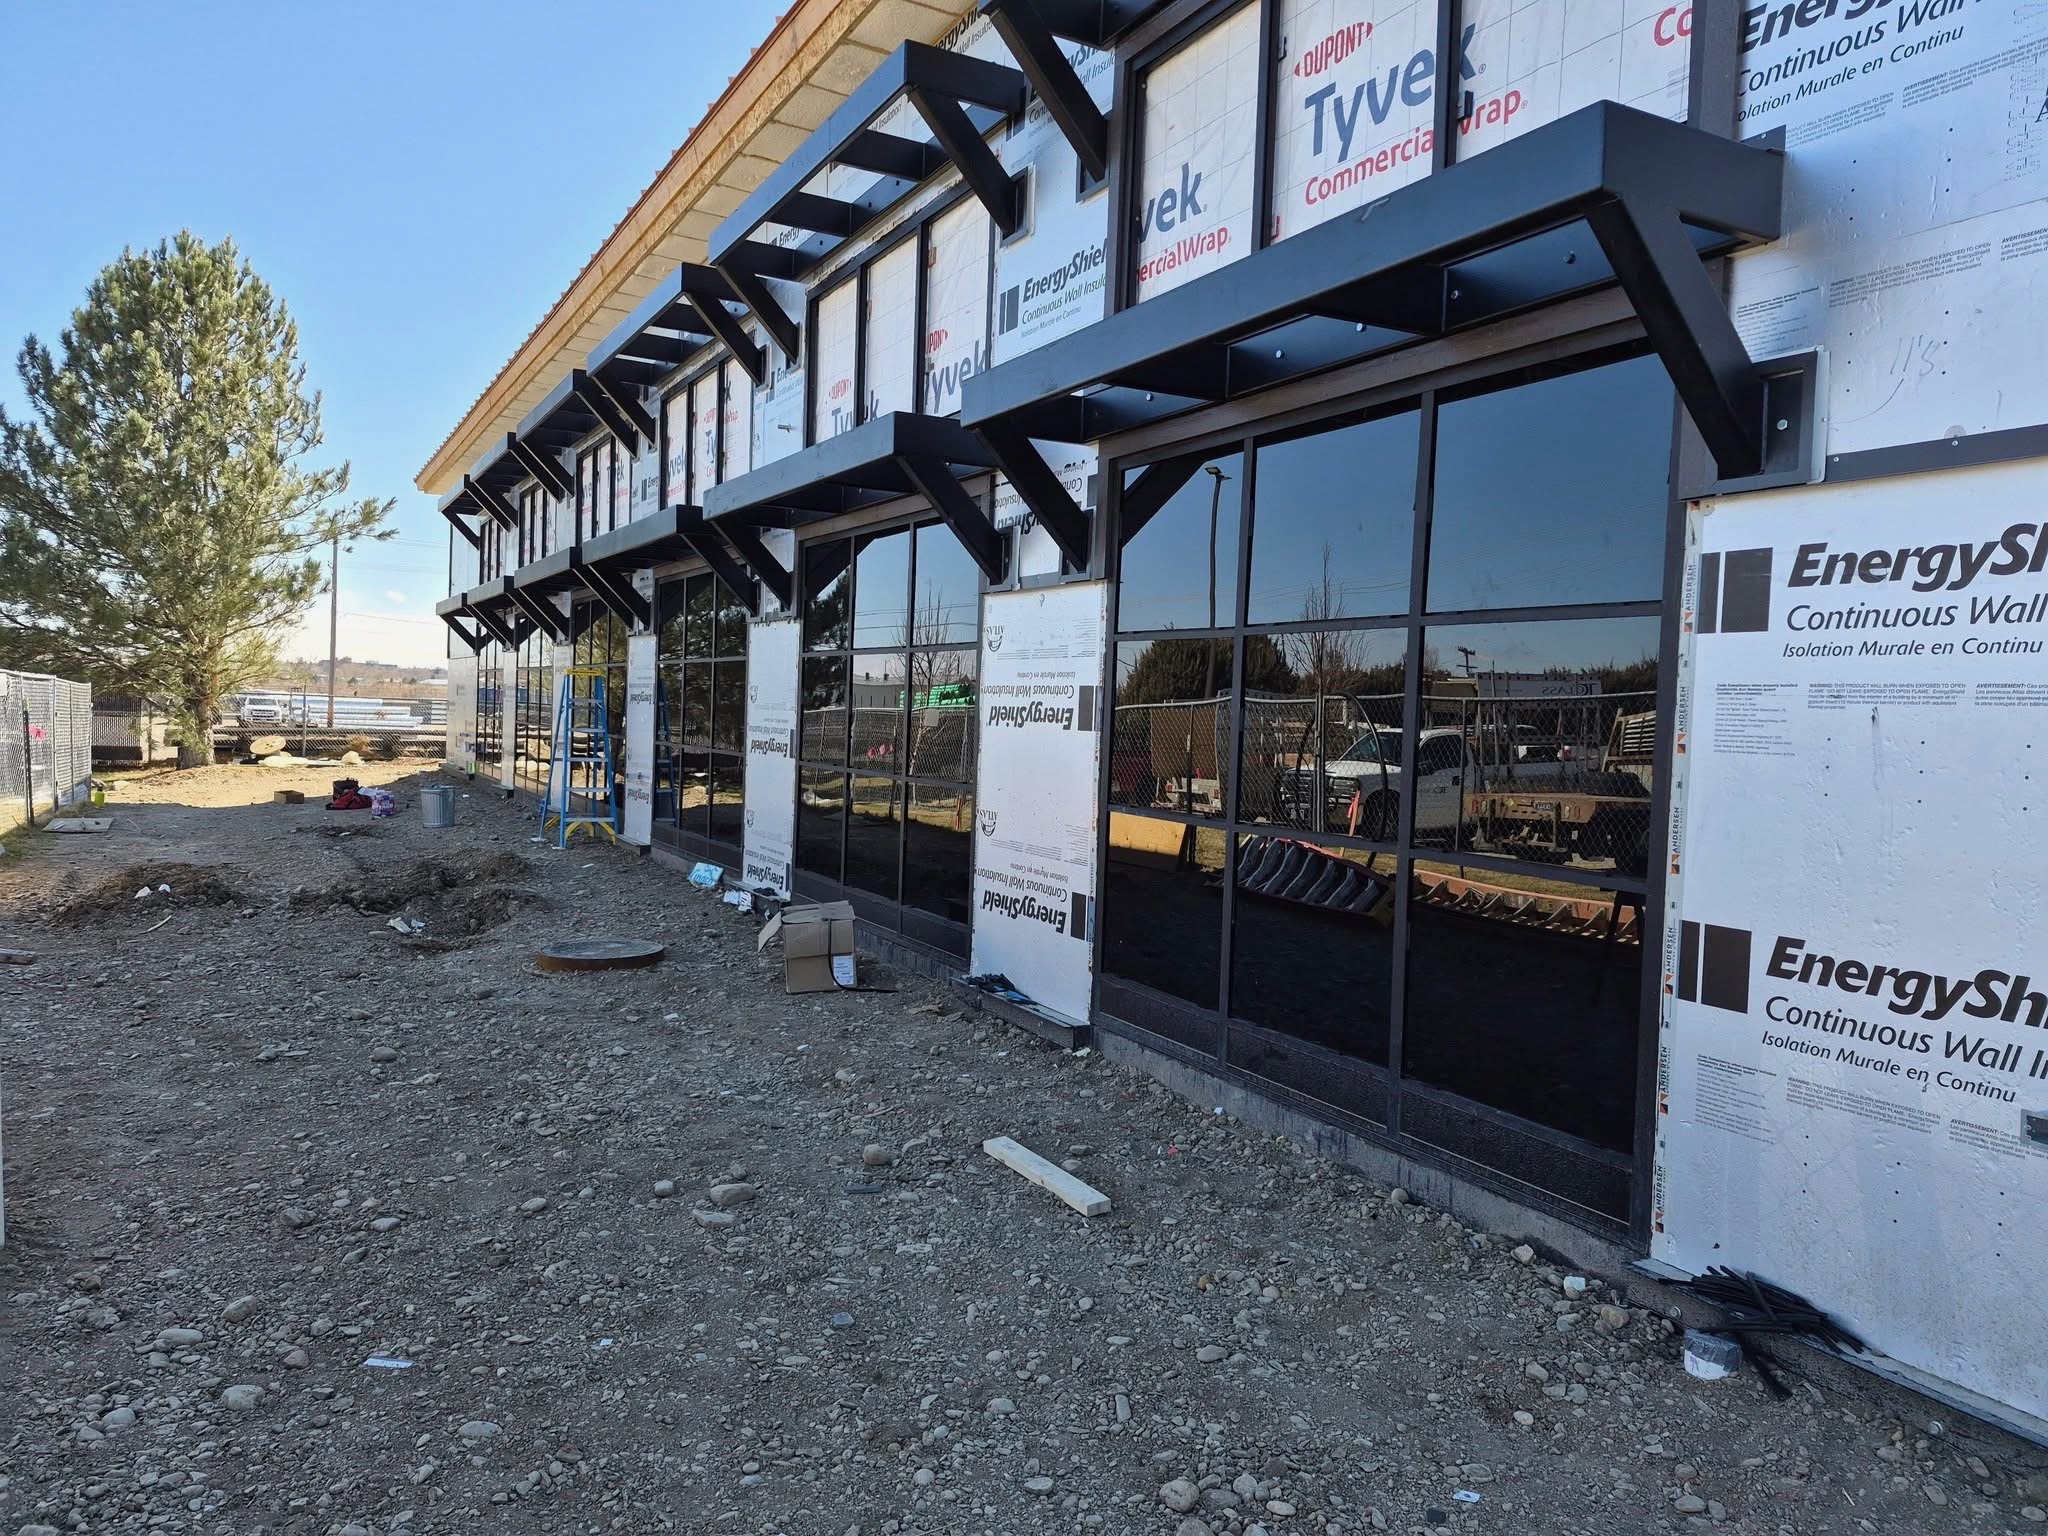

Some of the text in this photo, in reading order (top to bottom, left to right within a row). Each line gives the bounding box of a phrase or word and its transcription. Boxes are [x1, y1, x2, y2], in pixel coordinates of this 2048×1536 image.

[1304, 22, 1364, 77] DUPONT
[1796, 66, 1857, 101] Murale
[1862, 57, 1884, 74] en
[1890, 26, 1964, 63] Continu
[1137, 227, 1228, 282] ercialWrap
[1685, 564, 1694, 611] ANDERSEN
[1787, 593, 2048, 631] Continuous Wall
[1783, 637, 2043, 658] Isolation Murale en Continu
[1015, 685, 1031, 698] Wall
[1033, 685, 1075, 699] Continuous
[1678, 686, 1686, 733] ANDERSEN
[988, 701, 1074, 731] EnergyShield
[750, 737, 789, 758] EnergyShield
[1671, 807, 1680, 853] ANDERSEN
[746, 864, 784, 890] EnergyShield
[977, 867, 1068, 903] Continuous Wall Insulation
[982, 890, 1067, 934] EnergyShield
[1666, 927, 1674, 973] ANDERSEN
[1765, 996, 1933, 1053] Continuous
[1944, 1031, 2022, 1072] Wall
[1660, 1047, 1668, 1093] ANDERSEN
[1762, 1031, 2017, 1103] Isolation Murale en Continu
[1655, 1165, 1663, 1211] ANDERSEN
